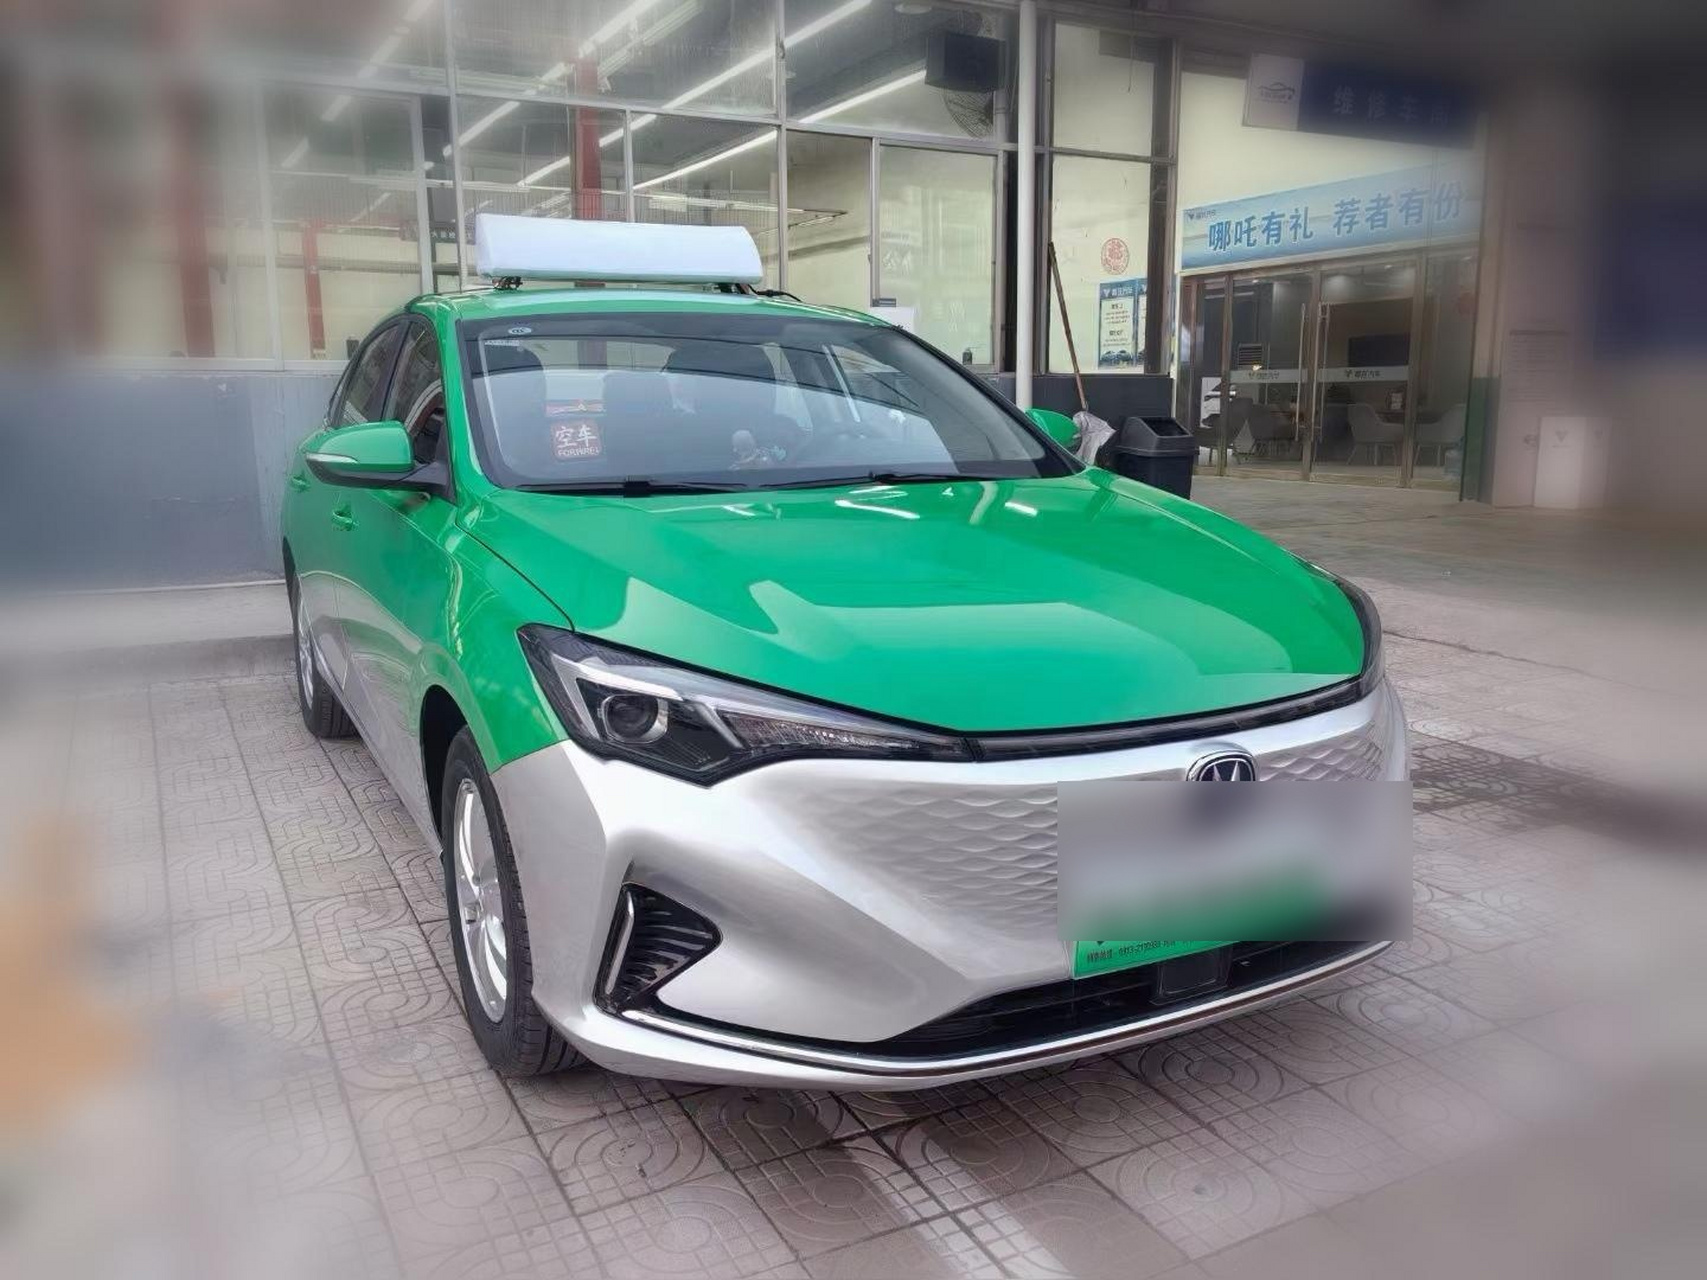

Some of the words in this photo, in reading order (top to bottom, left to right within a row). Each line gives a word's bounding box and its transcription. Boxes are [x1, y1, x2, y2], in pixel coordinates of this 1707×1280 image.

[1208, 206, 1314, 252] 哪吒有礼
[1333, 180, 1463, 236] 荐者有份
[555, 424, 597, 448] 空车
